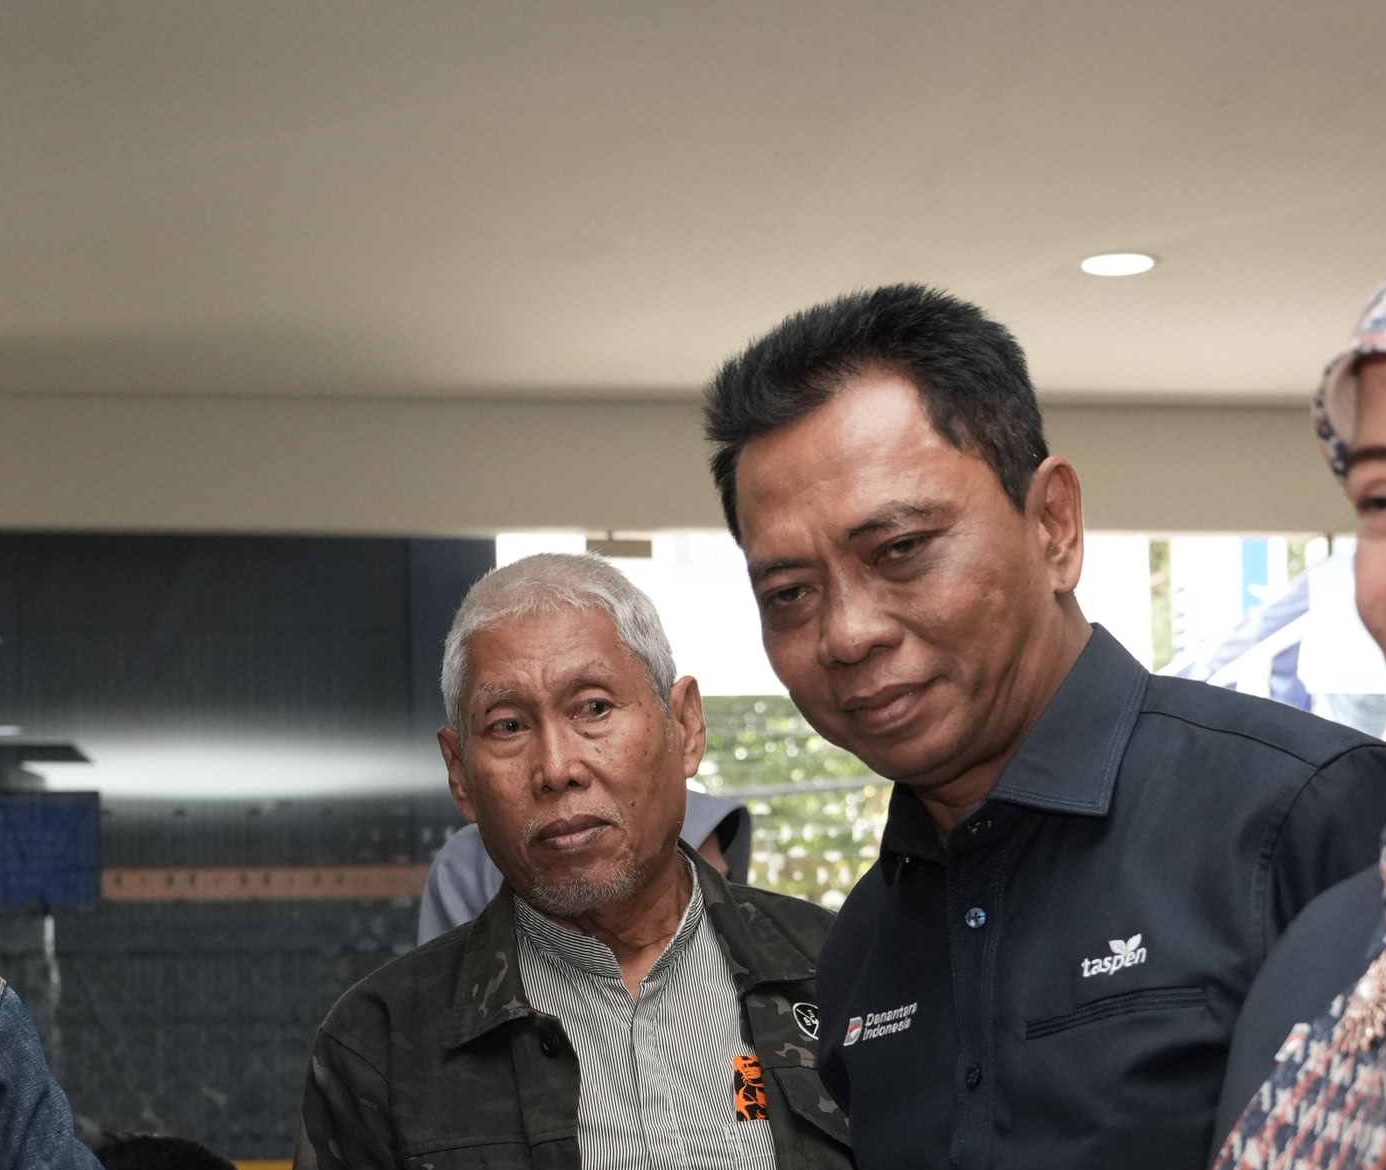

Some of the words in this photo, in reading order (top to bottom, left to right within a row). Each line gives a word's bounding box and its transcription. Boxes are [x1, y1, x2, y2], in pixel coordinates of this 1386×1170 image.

[1081, 947, 1147, 977] taspen
[864, 1002, 918, 1027] Danantara
[862, 1017, 912, 1041] Indonesia
